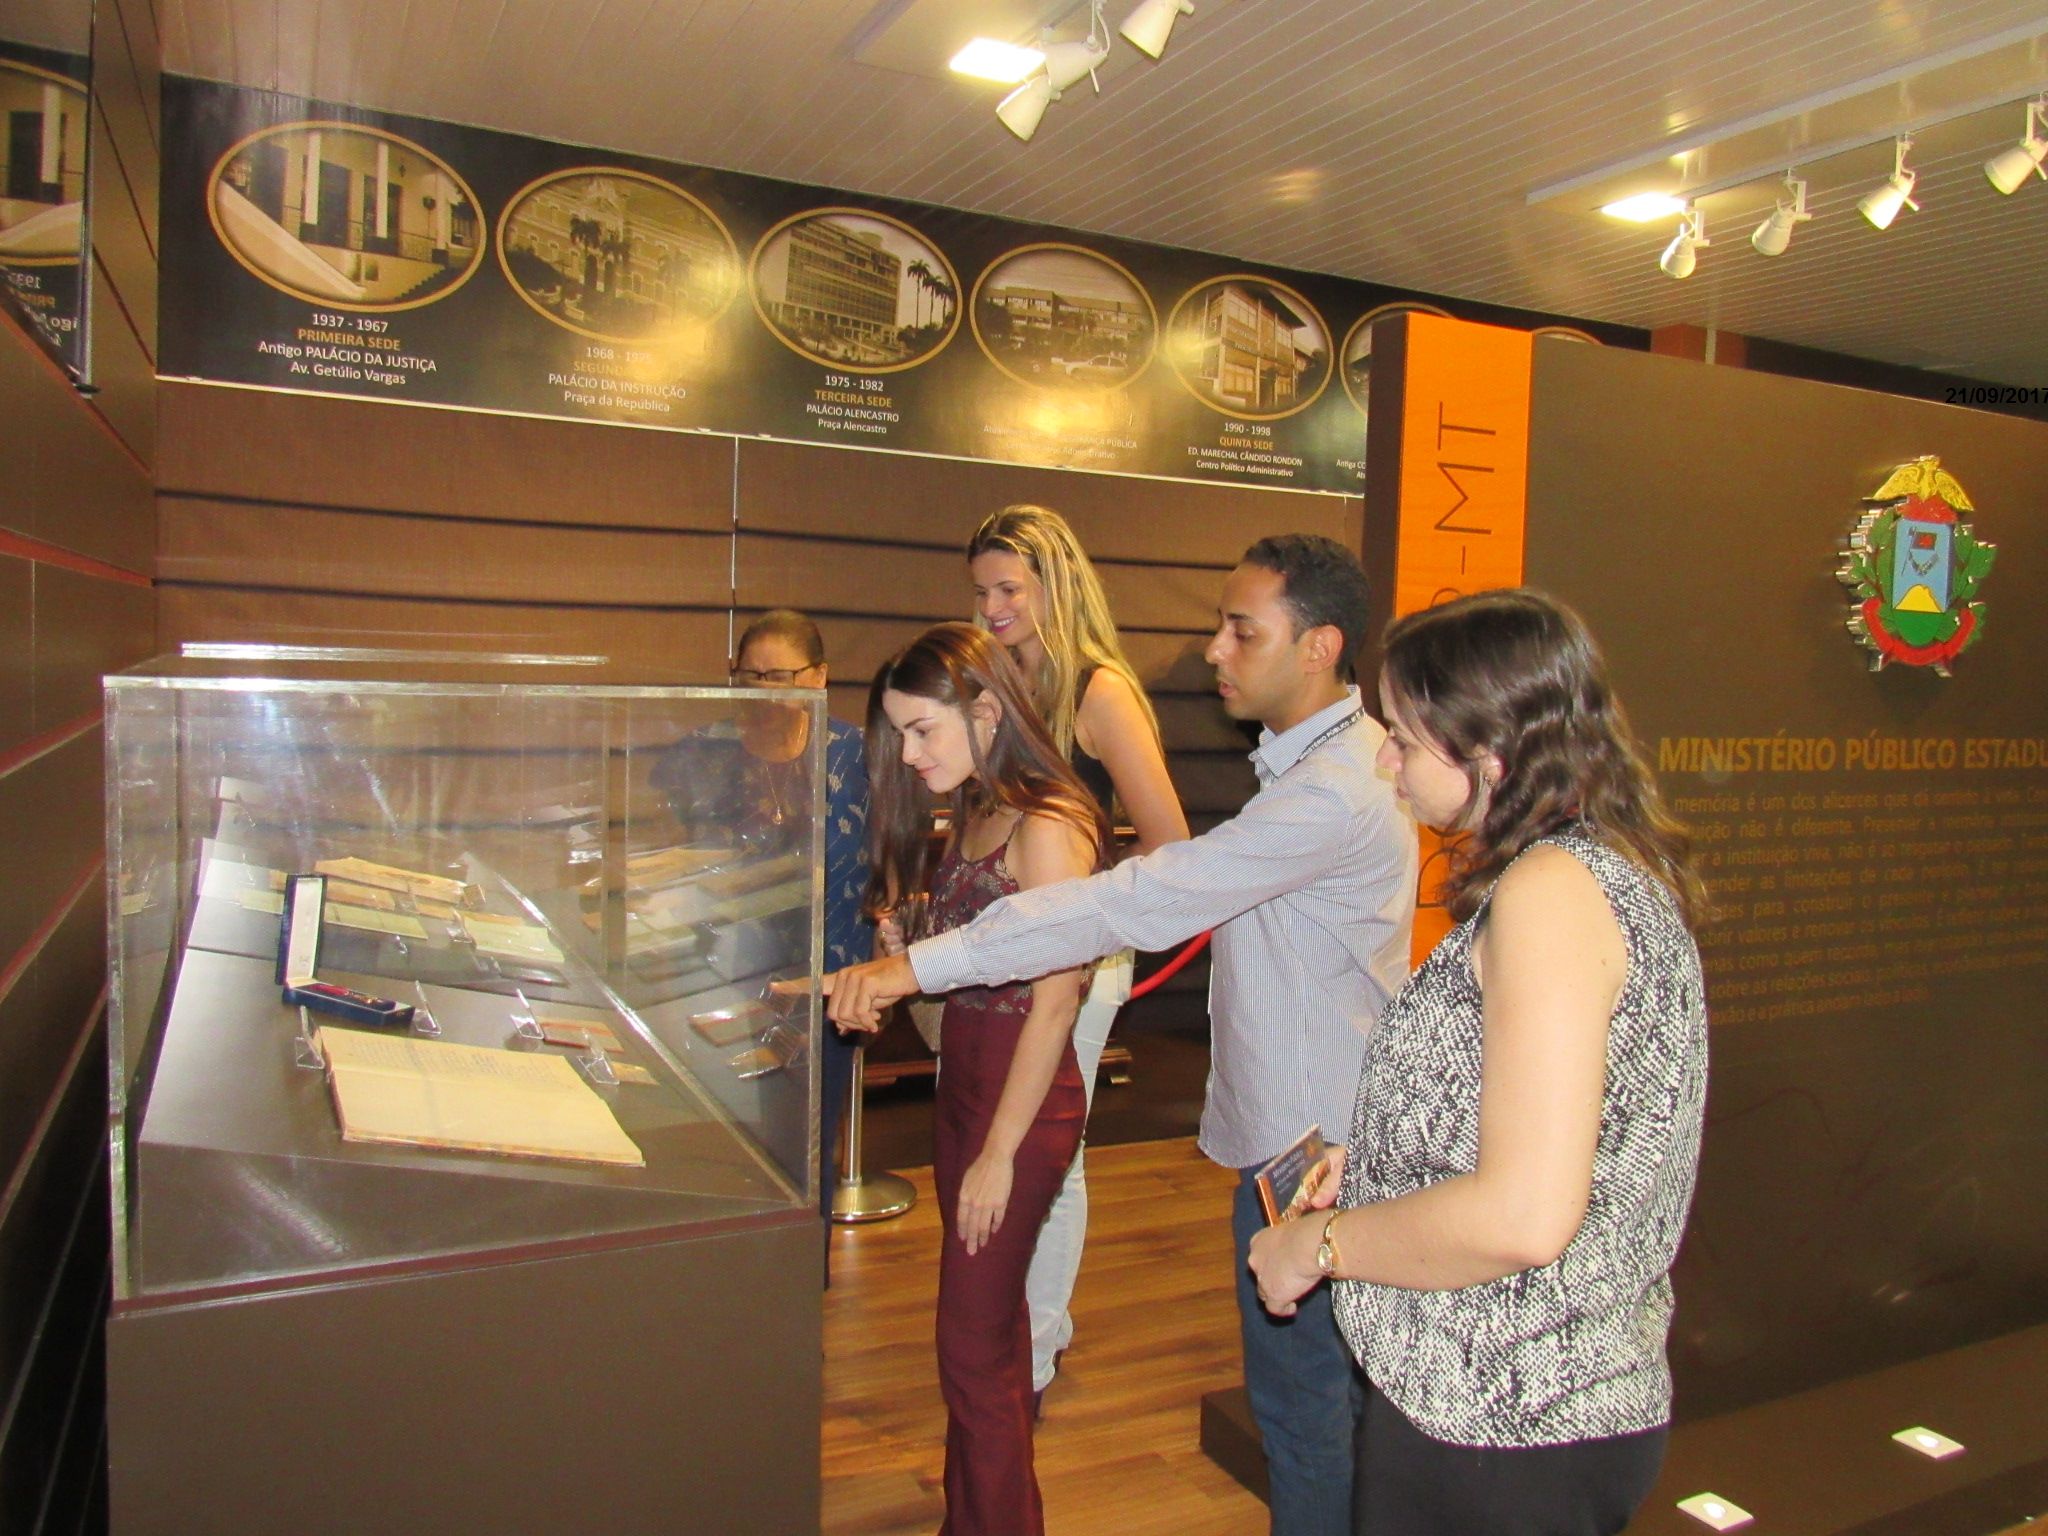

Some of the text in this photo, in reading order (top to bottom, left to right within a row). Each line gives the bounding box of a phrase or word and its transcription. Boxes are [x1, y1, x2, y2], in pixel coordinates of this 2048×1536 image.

[312, 313, 344, 328] 1937
[357, 318, 388, 333] 1967
[298, 328, 401, 351] PRIMEIRA SEDE
[258, 340, 437, 374] Antigo PALÁCIO DA JUSTIÇA
[587, 346, 615, 360] 1968
[290, 361, 406, 386] Av. Getúlio Vargas
[573, 361, 627, 376] SEGUND
[548, 373, 686, 399] PALÁCIO DA INSTRUÇÃO
[825, 374, 850, 388] 1975
[860, 379, 884, 391] 1982
[564, 390, 670, 413] Praça da República
[815, 389, 892, 408] TERCEIRA SEDE
[806, 403, 900, 423] PALÁCIO ALENCASTRO
[818, 418, 887, 434] Praça Alencastro
[1224, 422, 1244, 434] 1990
[1251, 425, 1271, 436] 1998
[1220, 436, 1274, 451] QUINTA SEDE
[1187, 447, 1303, 467] ED. MARECHAL CÂNDIDO RONDON
[1336, 459, 1356, 470] Antiga
[1196, 460, 1294, 478] Centro Político Administrativo
[1659, 728, 1836, 773] MINISTÉRIO
[1845, 729, 1956, 771] PÚBLICO
[1675, 793, 1740, 812] memória
[1746, 792, 1755, 811] é
[1762, 796, 1785, 811] um
[1791, 792, 1816, 810] dos
[1689, 821, 1731, 843] uição
[1740, 820, 1766, 838] não
[1775, 817, 1784, 837] é
[1712, 853, 1721, 866] a
[1727, 845, 1798, 867] instituição
[1838, 842, 1863, 860] não
[1705, 875, 1751, 893] ender
[1759, 876, 1776, 890] as
[1859, 868, 1876, 884] de
[1753, 901, 1785, 921] para
[1738, 924, 1788, 944] valores
[1739, 954, 1779, 970] como
[1712, 1005, 1745, 1025] exão
